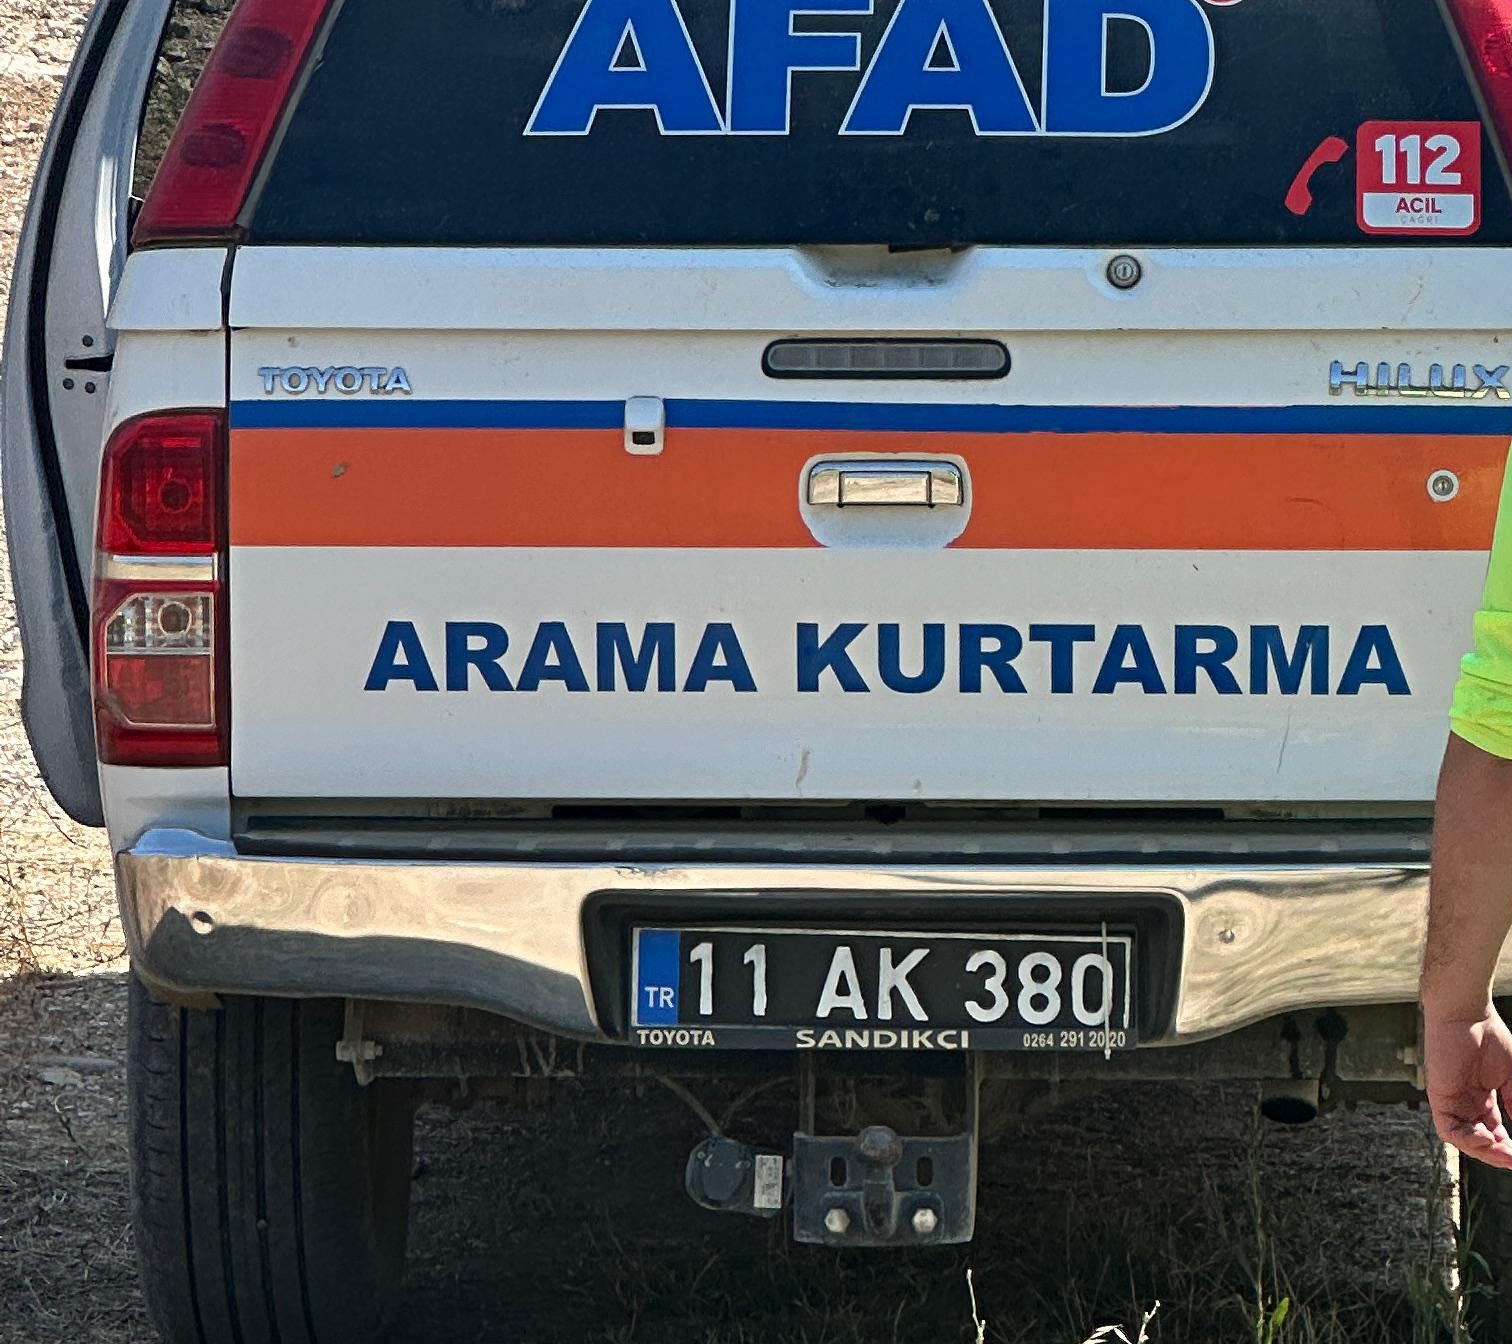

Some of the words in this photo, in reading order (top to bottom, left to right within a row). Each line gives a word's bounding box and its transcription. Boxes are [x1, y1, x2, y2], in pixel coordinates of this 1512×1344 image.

[1374, 134, 1462, 185] 112
[258, 366, 413, 395] TOYOTA
[1329, 360, 1511, 400] HILUX
[363, 620, 759, 693] ARAMA
[796, 622, 1412, 696] KURTARMA
[644, 986, 675, 1009] TR
[689, 941, 768, 1017] 11
[815, 945, 931, 1022] AK
[964, 949, 1114, 1027] 380
[636, 1029, 716, 1046] TOYOTA
[1023, 1032, 1054, 1048] 0264
[1060, 1031, 1084, 1047] 291
